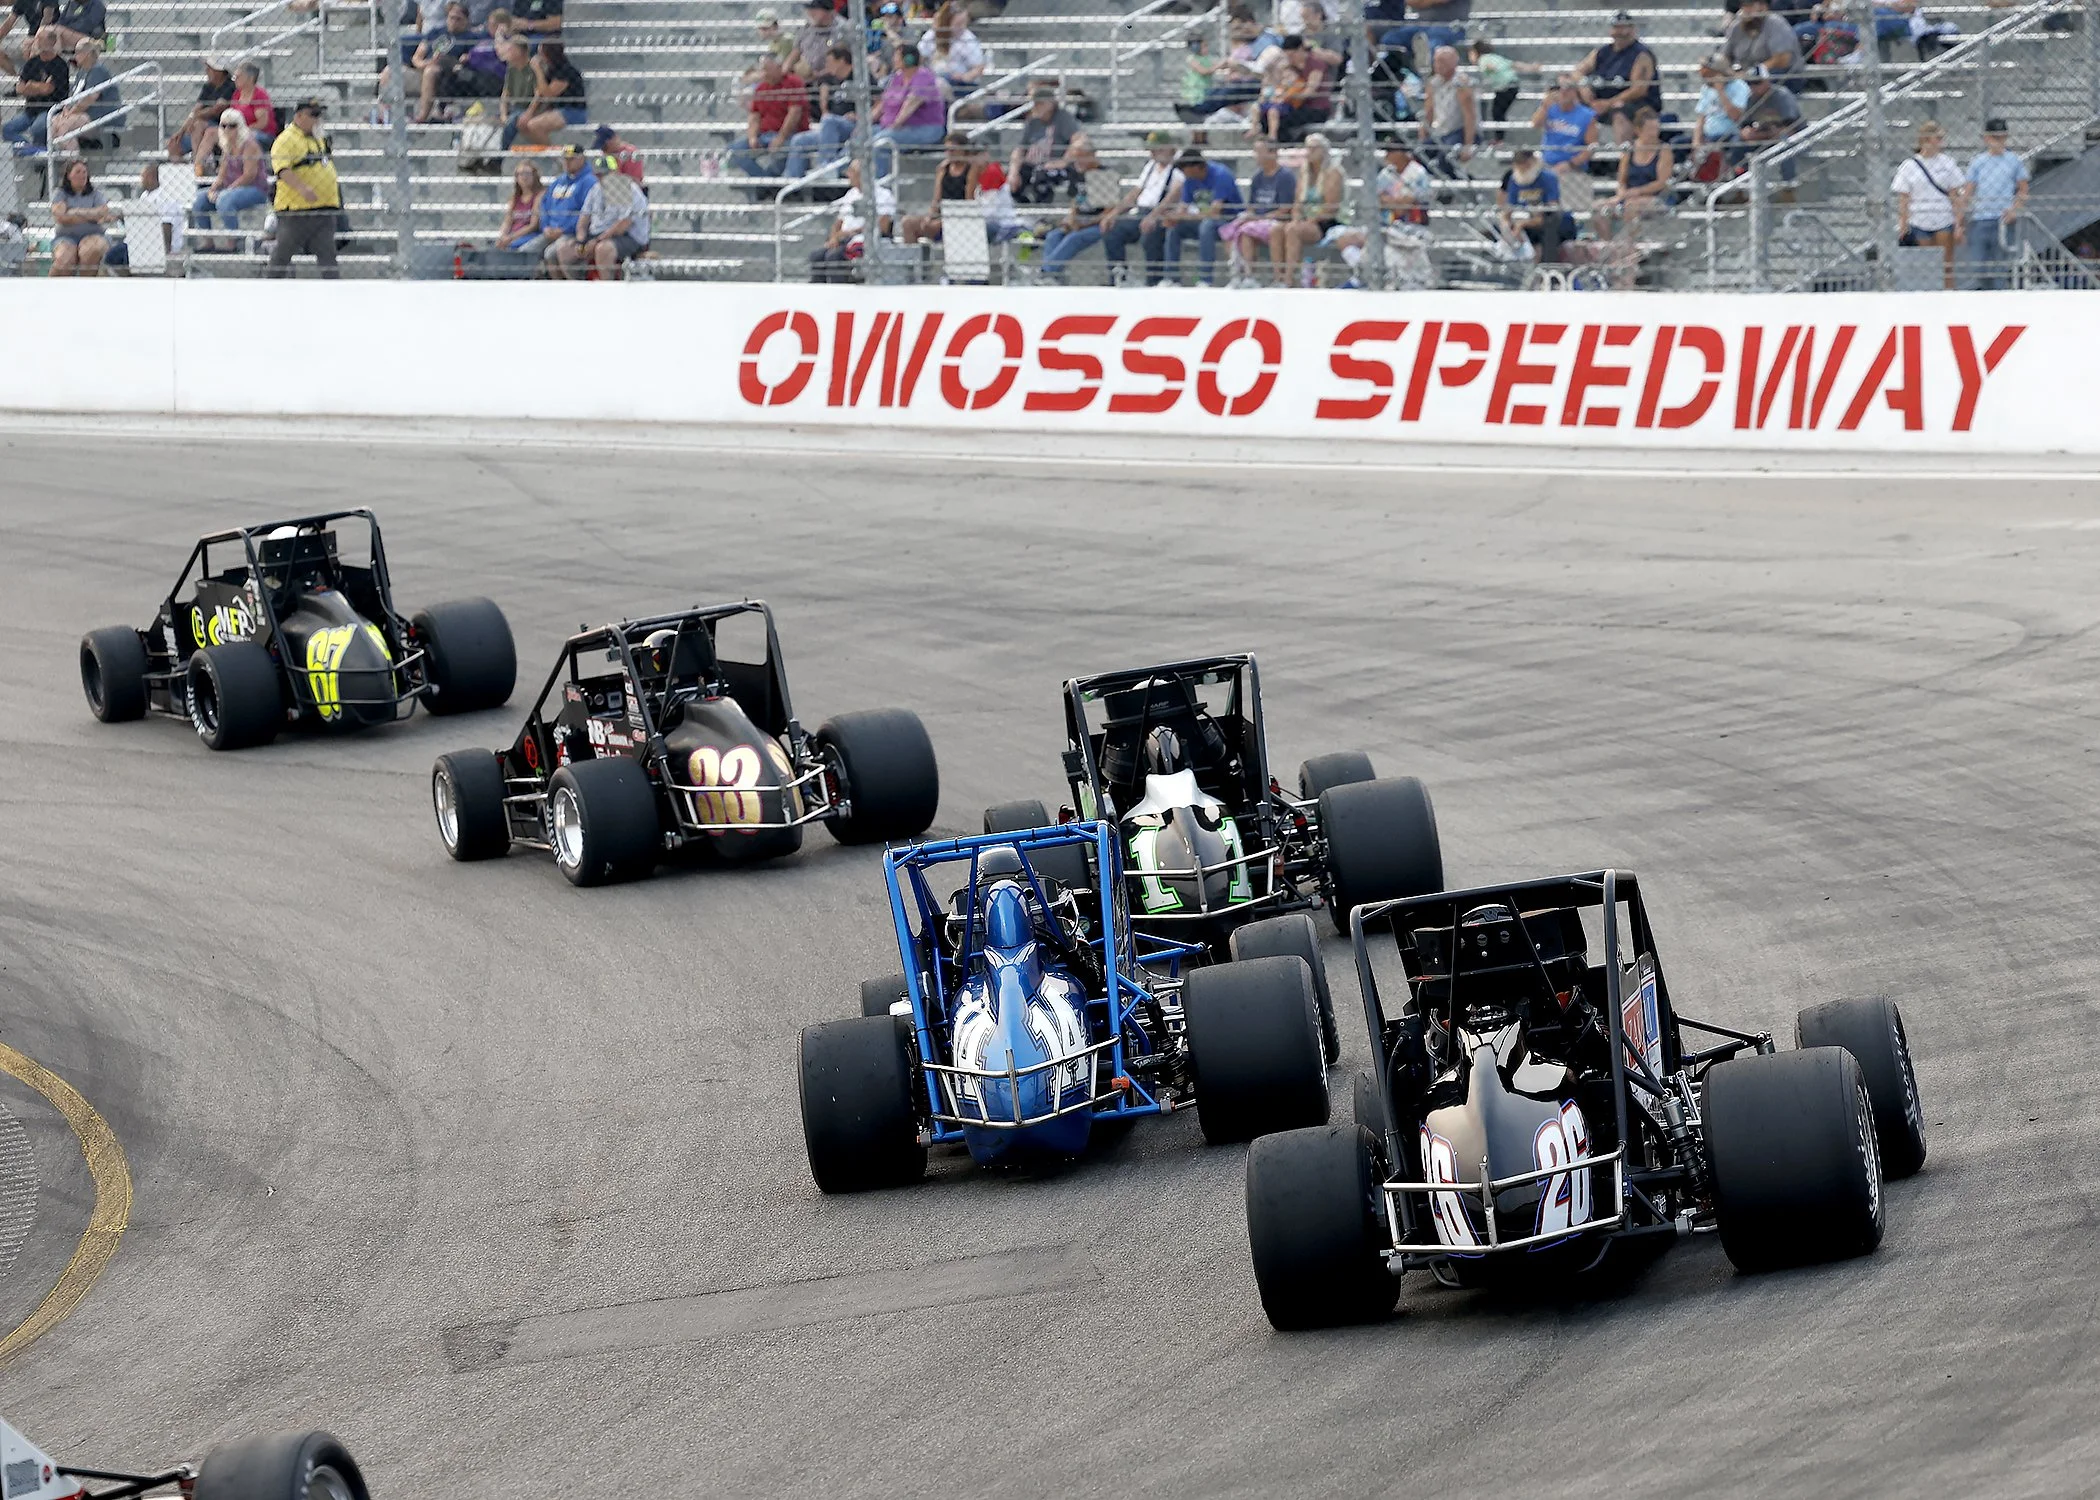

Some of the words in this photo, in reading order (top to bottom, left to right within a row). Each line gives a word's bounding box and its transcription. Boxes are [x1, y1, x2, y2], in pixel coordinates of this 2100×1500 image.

[739, 309, 1283, 417] OWOSSO
[1314, 319, 2028, 432] SPEEDWAY
[1530, 1098, 1592, 1253] 26
